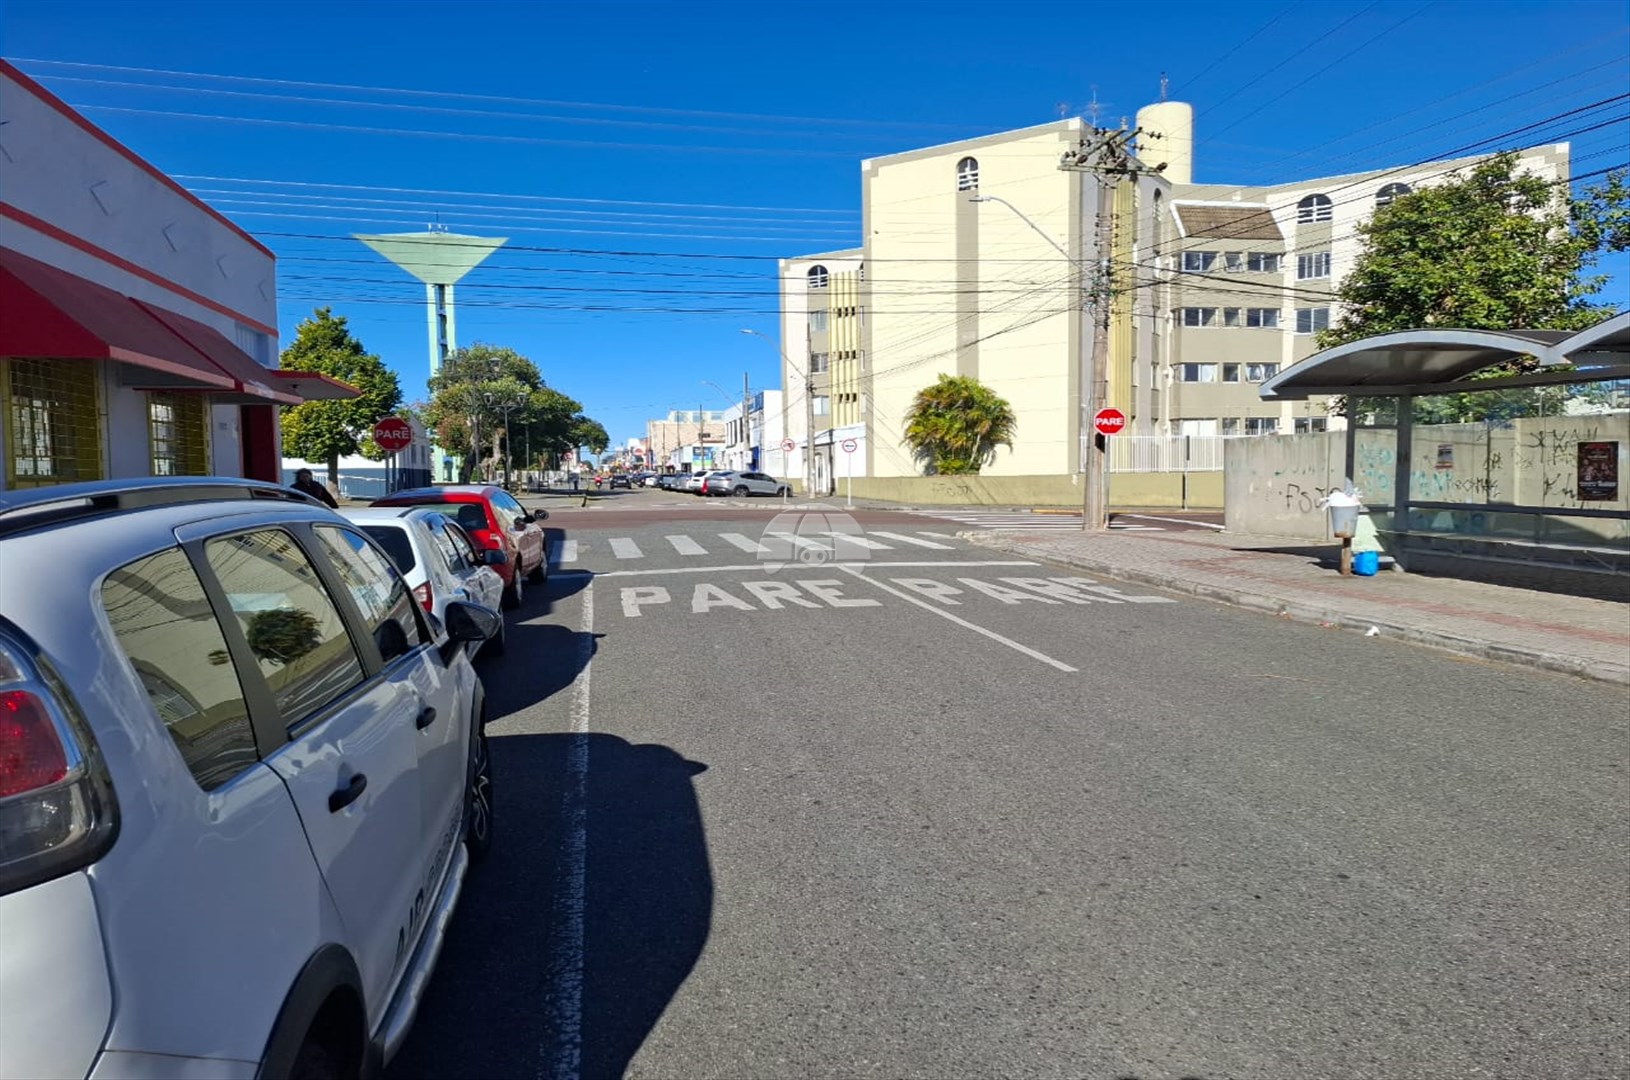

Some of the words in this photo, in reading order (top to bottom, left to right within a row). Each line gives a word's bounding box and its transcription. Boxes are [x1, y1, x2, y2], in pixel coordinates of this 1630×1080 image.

[1095, 417, 1125, 426] PARE
[375, 429, 410, 440] PARE
[620, 579, 883, 617] PARE
[889, 577, 1178, 605] PARE
